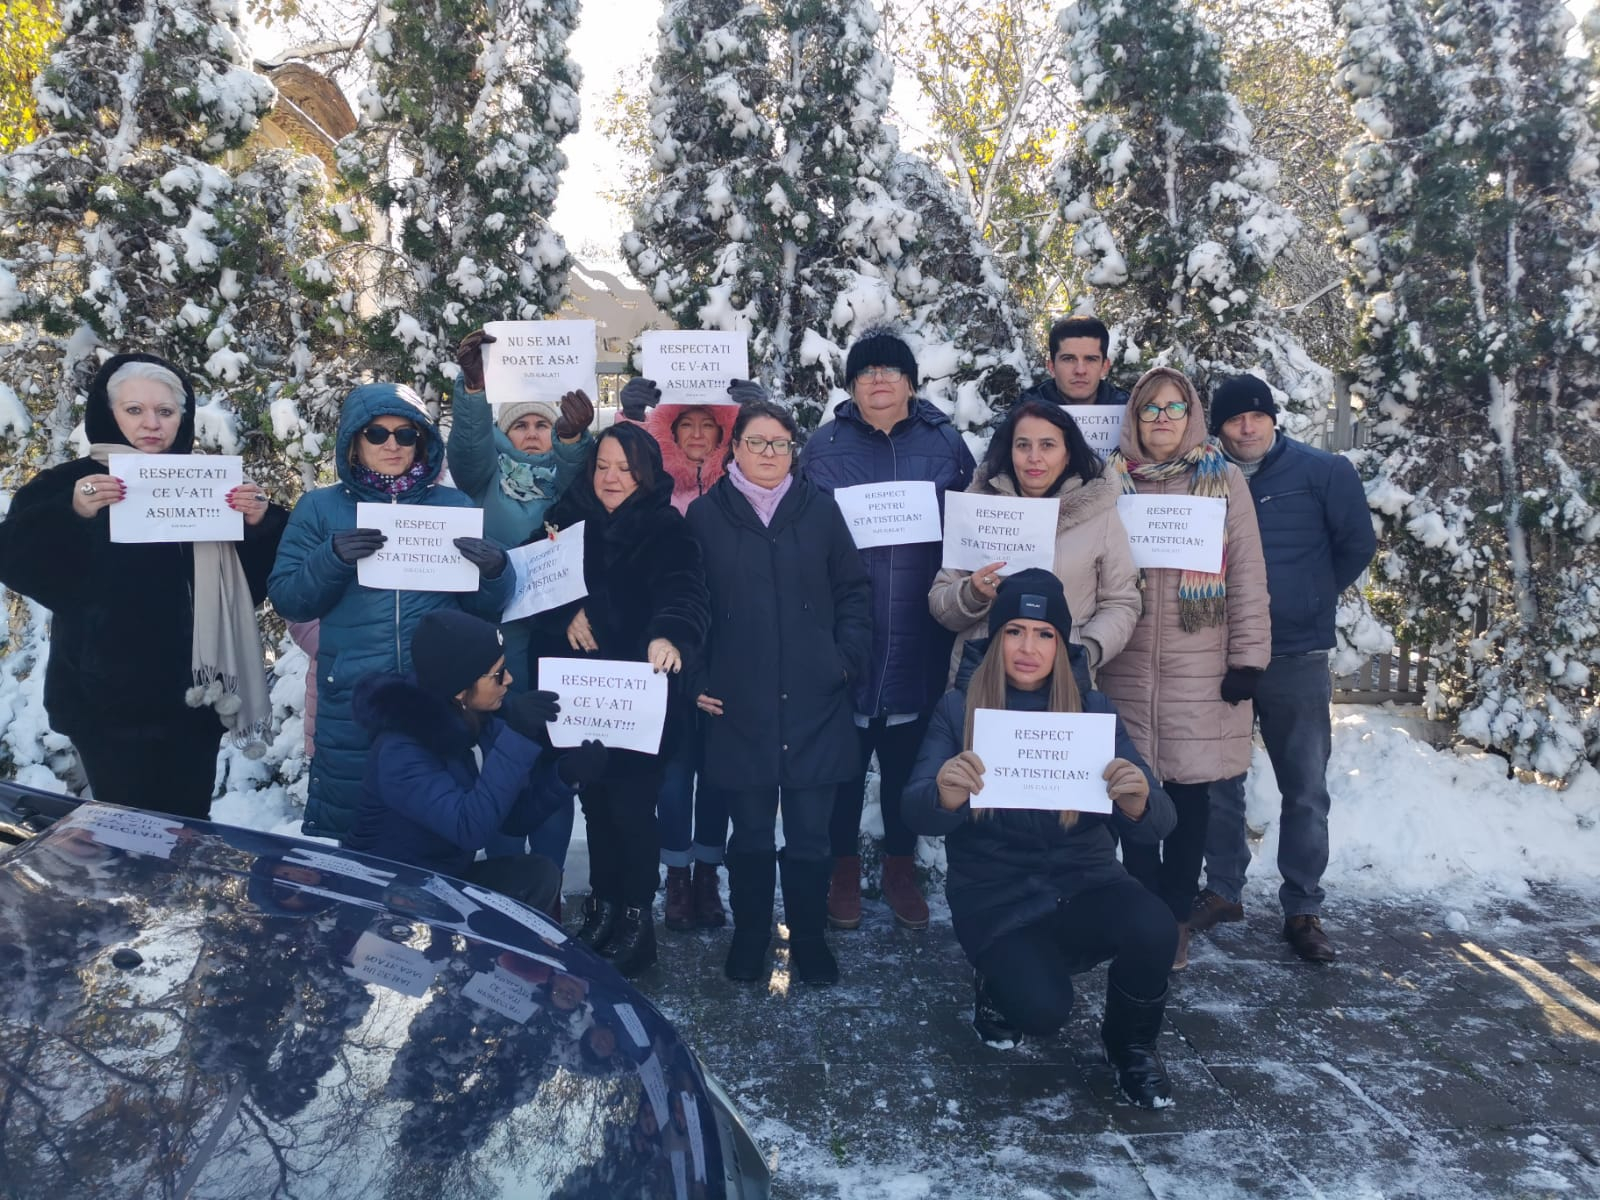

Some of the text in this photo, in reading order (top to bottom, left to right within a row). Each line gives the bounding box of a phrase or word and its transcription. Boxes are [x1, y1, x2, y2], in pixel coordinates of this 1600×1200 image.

[507, 335, 571, 347] NU SE MAI
[660, 344, 731, 354] RESPECTATI
[502, 355, 580, 366] POATE ASA!
[671, 361, 720, 371] CE V-ATI
[666, 379, 726, 389] ASUMAT!!!
[139, 468, 228, 479] RESPECTATI
[152, 486, 213, 498] CE V-ATI
[865, 490, 907, 500] RESPECT
[868, 502, 905, 511] PENTRU
[1146, 507, 1192, 516] RESPECT
[145, 507, 221, 518] ASUMAT!!!
[976, 508, 1025, 520] RESPECT
[395, 519, 447, 530] RESPECT
[853, 513, 922, 527] STATISTICIAN!
[1148, 521, 1188, 530] PENTRU
[978, 525, 1020, 536] PENTRU
[398, 536, 443, 547] PENTRU
[960, 537, 1036, 552] STATISTICIAN!
[1129, 535, 1204, 547] STATISTICIAN!
[377, 552, 461, 564] STATISTICIAN!
[561, 674, 647, 690] RESPECTATI
[573, 696, 633, 711] CE V-ATI
[562, 715, 636, 730] ASUMAT!!!
[1014, 729, 1074, 742] RESPECT
[1018, 749, 1069, 761] PENTRU
[994, 767, 1089, 780] STATISTICIAN!
